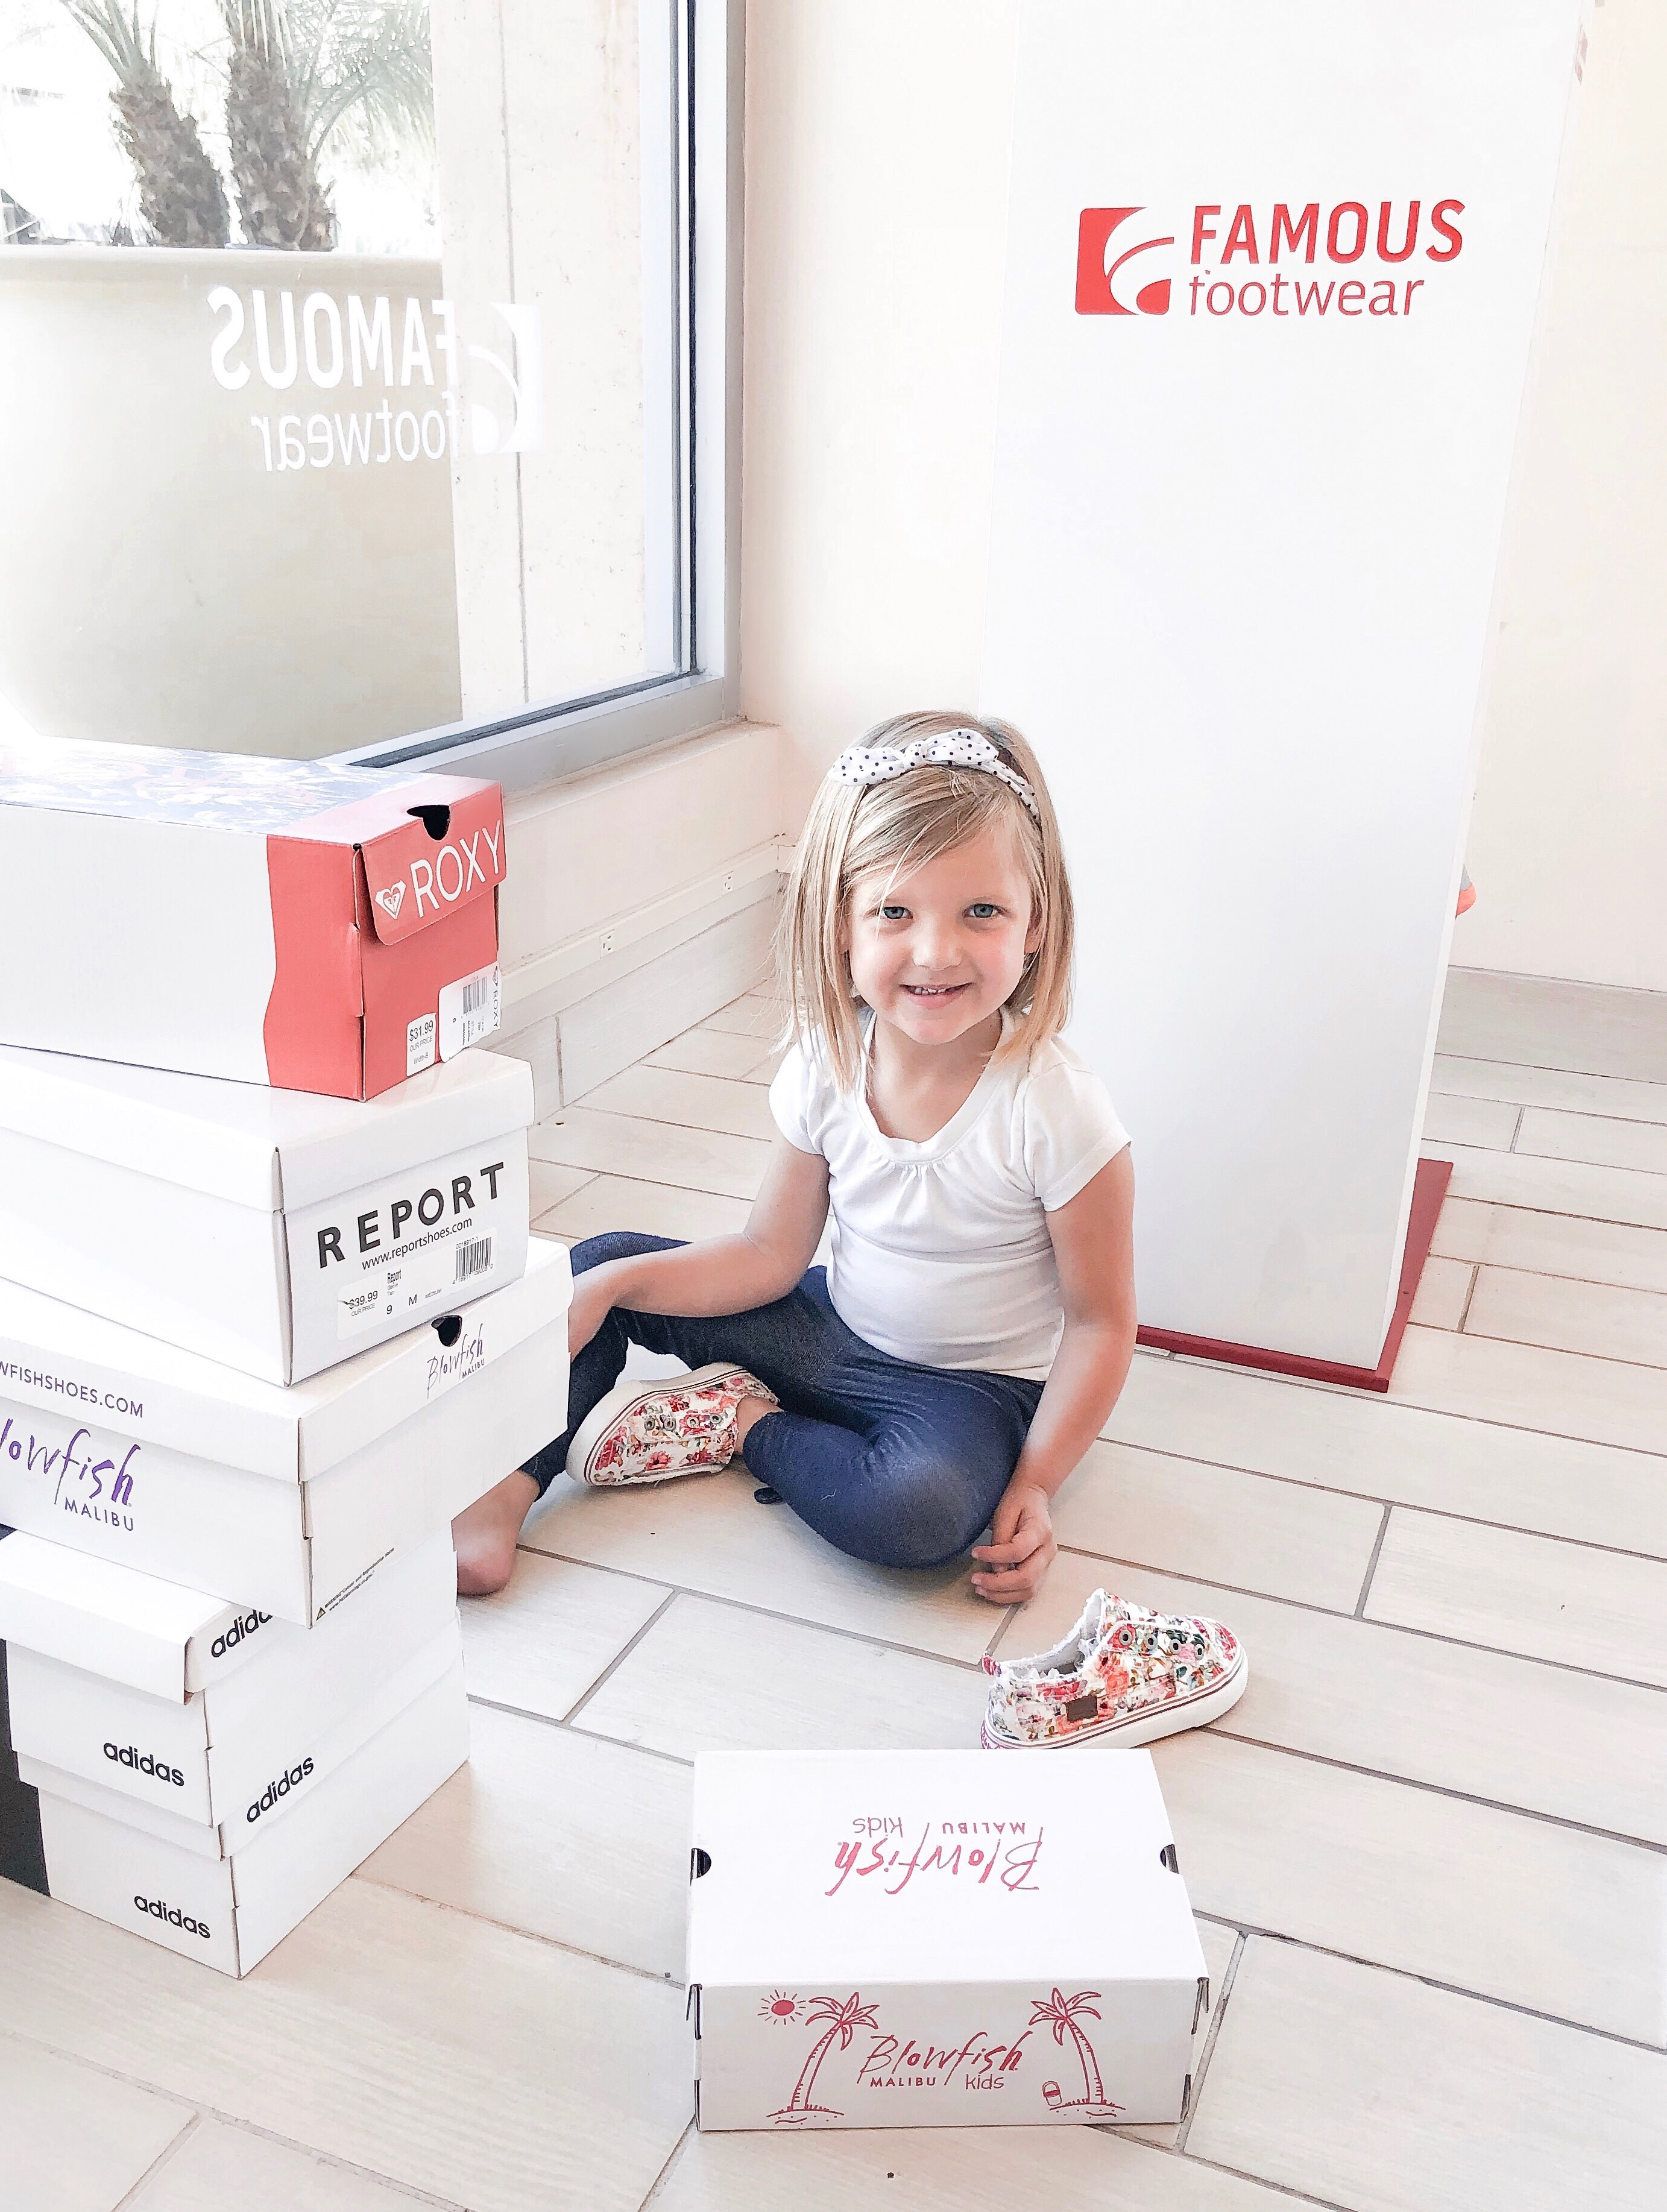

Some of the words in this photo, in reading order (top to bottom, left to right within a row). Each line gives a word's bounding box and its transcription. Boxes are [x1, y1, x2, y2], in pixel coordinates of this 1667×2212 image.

[1191, 200, 1465, 263] FAMOUS
[1189, 270, 1424, 315] footwear
[410, 819, 500, 918] ROXY
[409, 1020, 433, 1042] $31.99
[410, 1042, 420, 1051] OUR
[420, 1035, 433, 1047] PRICE
[318, 1162, 503, 1268] REPORT
[362, 1218, 472, 1270] www.reportshoes.com
[388, 1268, 402, 1285] Report
[349, 1291, 378, 1309] $39.99
[386, 1305, 392, 1314] 9
[409, 1294, 417, 1306] M
[426, 1323, 483, 1399] Blowfish
[462, 1358, 485, 1379] MALIBU
[65, 1496, 133, 1531] MALIBU
[103, 1742, 184, 1786] adidas
[247, 1757, 314, 1823] adidas
[852, 1817, 903, 1838] kids
[942, 1822, 1026, 1835] MALIBU
[825, 1822, 1044, 1896] Blowfish
[134, 1895, 211, 1938] adidas
[857, 2031, 1033, 2085] Blowfish
[870, 2077, 936, 2087] MALIBU
[965, 2073, 1005, 2090] kids
